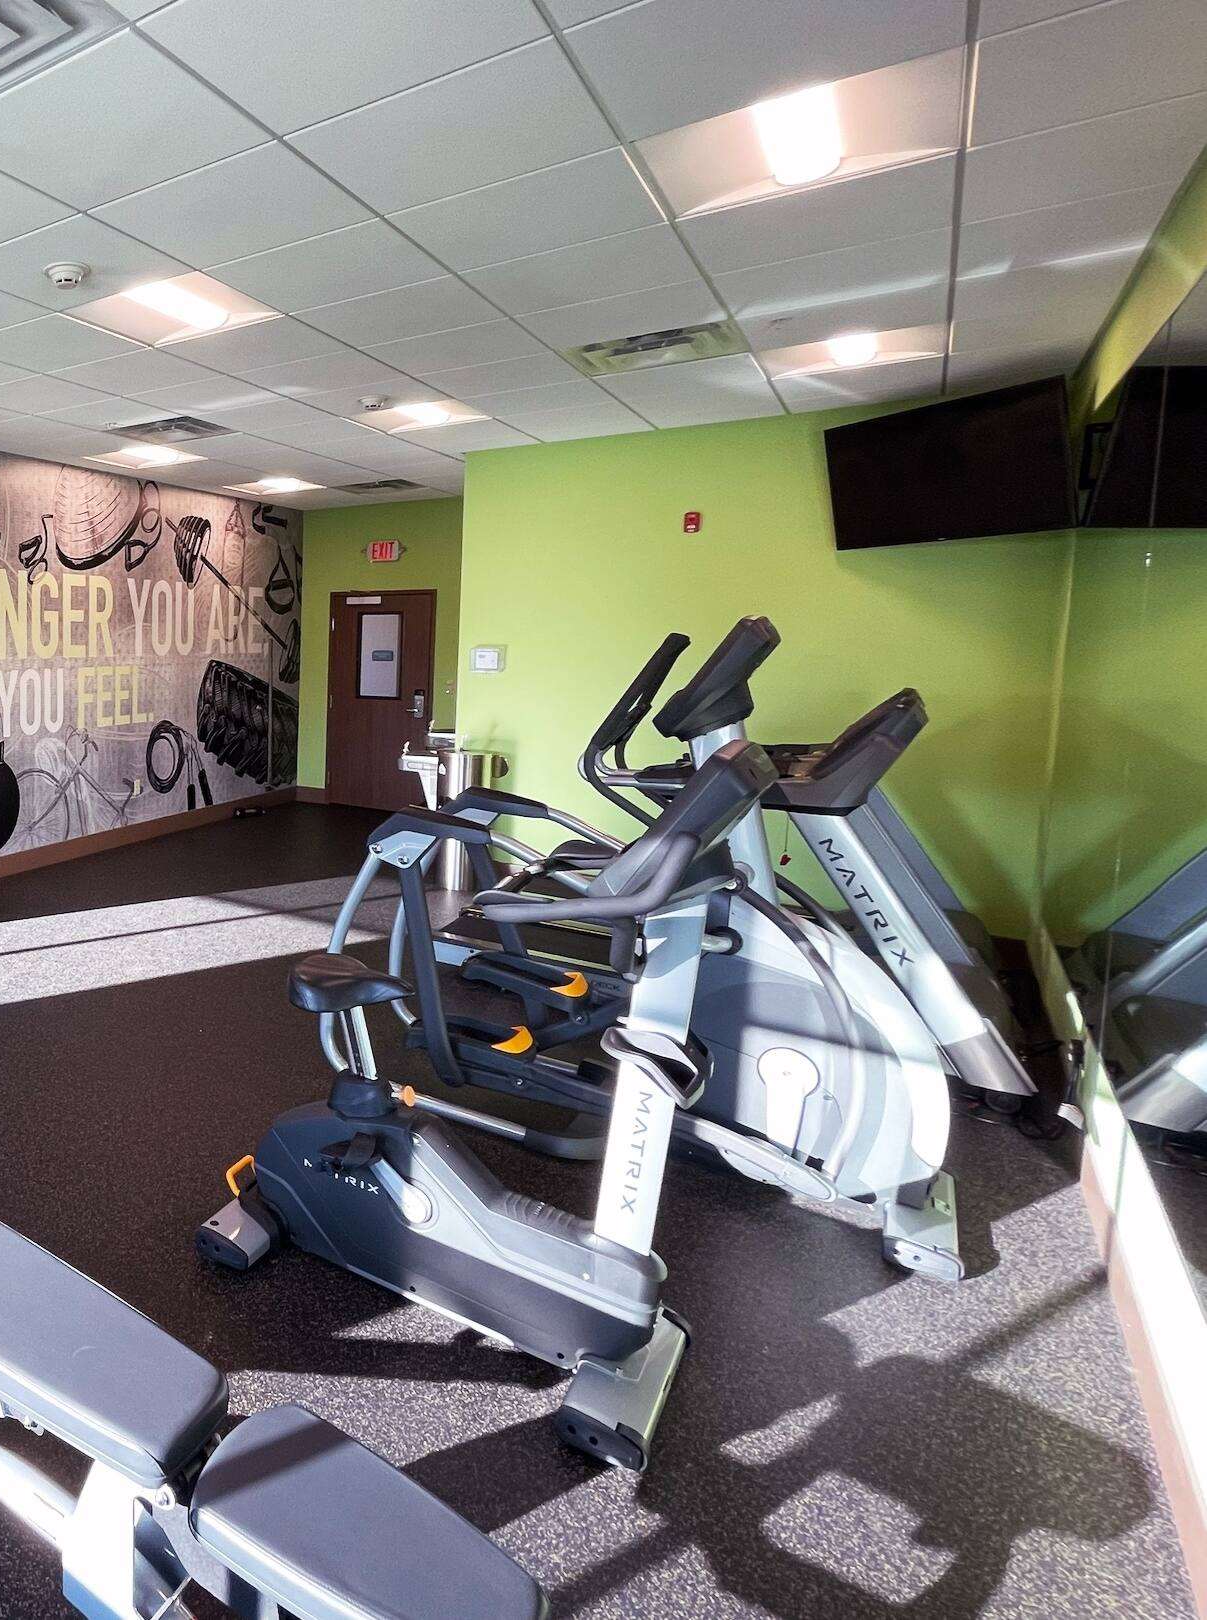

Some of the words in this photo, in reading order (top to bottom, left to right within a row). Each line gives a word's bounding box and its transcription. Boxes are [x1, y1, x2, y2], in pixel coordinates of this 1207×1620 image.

[372, 542, 395, 560] EXIT
[126, 577, 194, 657] YOU
[75, 665, 155, 729] FEEL.
[818, 838, 915, 967] MATRIX
[303, 1158, 380, 1196] MRIX
[620, 1091, 654, 1214] MATRIX
